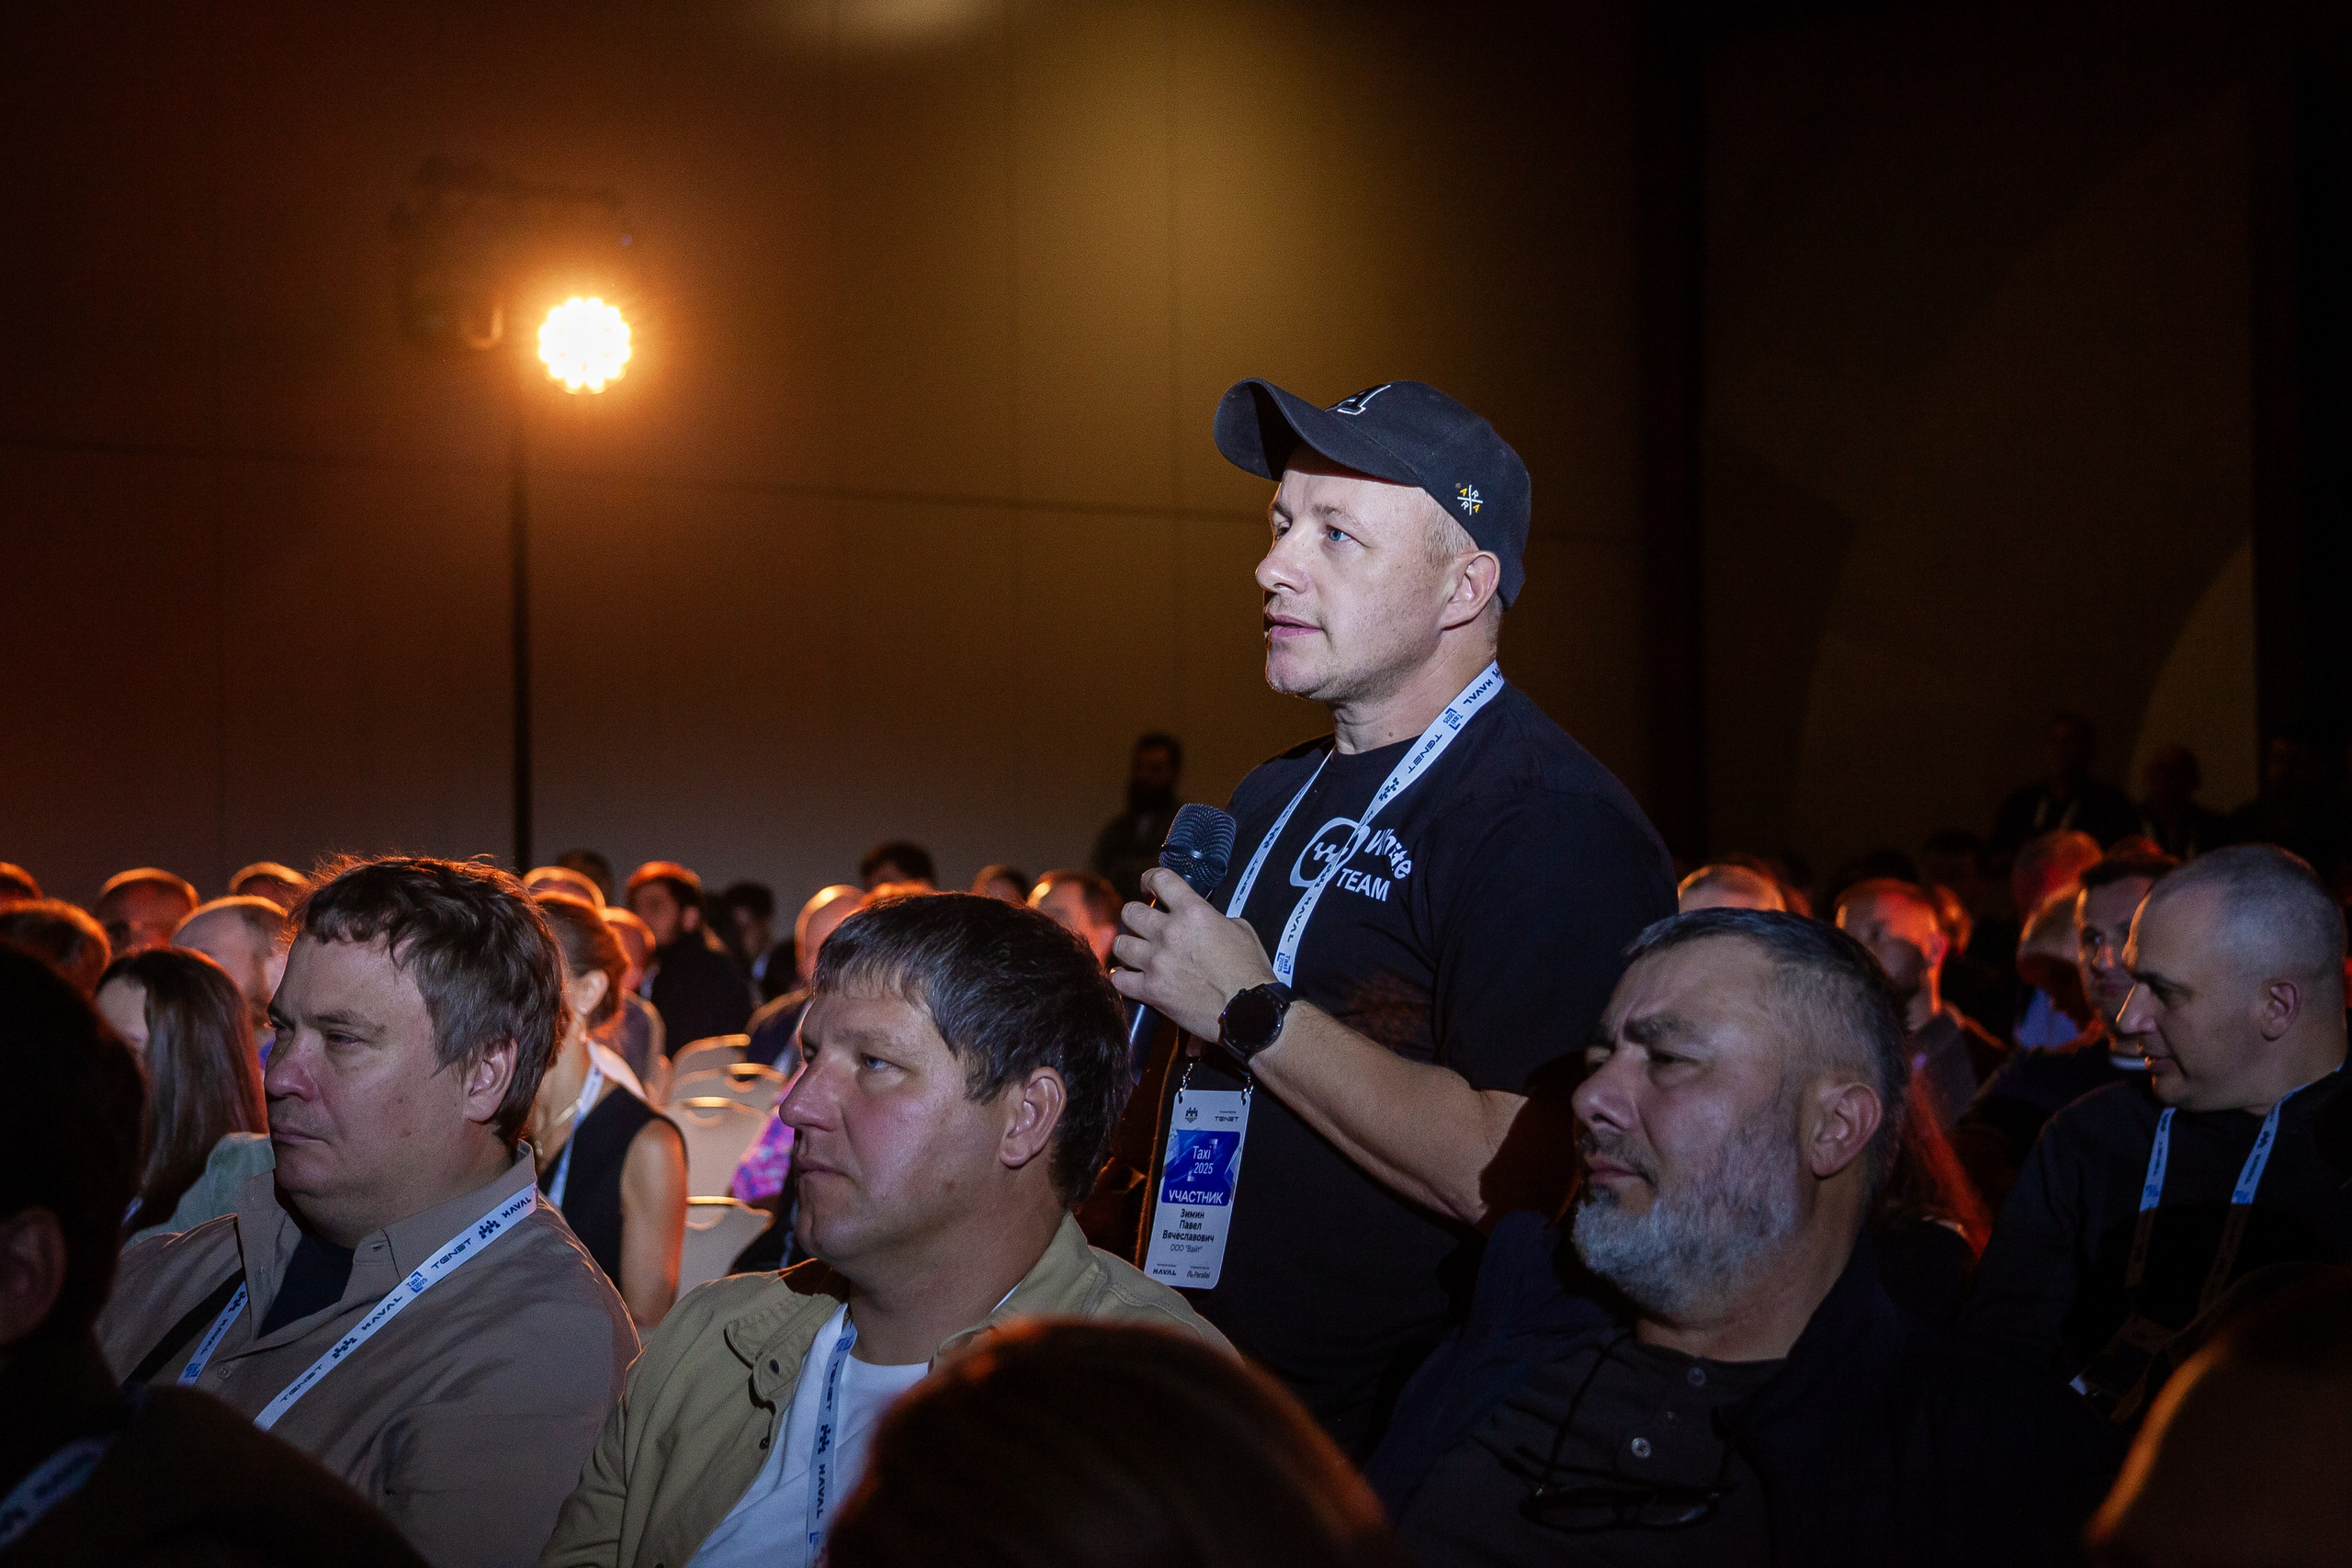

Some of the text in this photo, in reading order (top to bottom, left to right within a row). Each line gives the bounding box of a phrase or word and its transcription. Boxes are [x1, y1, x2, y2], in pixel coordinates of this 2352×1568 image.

[1463, 678, 1494, 705] HAVAL
[1442, 711, 1455, 725] 2025
[1451, 713, 1464, 726] Taxi
[1408, 734, 1443, 774] TENET
[1363, 829, 1412, 879] White
[1336, 867, 1391, 902] TEAM
[1286, 897, 1313, 943] HAVAL
[1193, 1145, 1213, 1160] Taxi
[1193, 1161, 1214, 1175] 2025
[1169, 1189, 1225, 1205] УЧАСТНИК
[502, 1196, 532, 1219] HAVAL
[1180, 1208, 1205, 1220] Зимин
[1179, 1219, 1203, 1231] Павел
[1161, 1229, 1215, 1244] Вячеславович
[430, 1237, 471, 1269] TENET
[1170, 1243, 1185, 1253] ООО
[1152, 1268, 1177, 1276] HAVAL
[405, 1276, 421, 1288] Taxi
[361, 1296, 403, 1331] HAVAL
[279, 1363, 322, 1403] TENET
[816, 1463, 826, 1519] HAVAL
